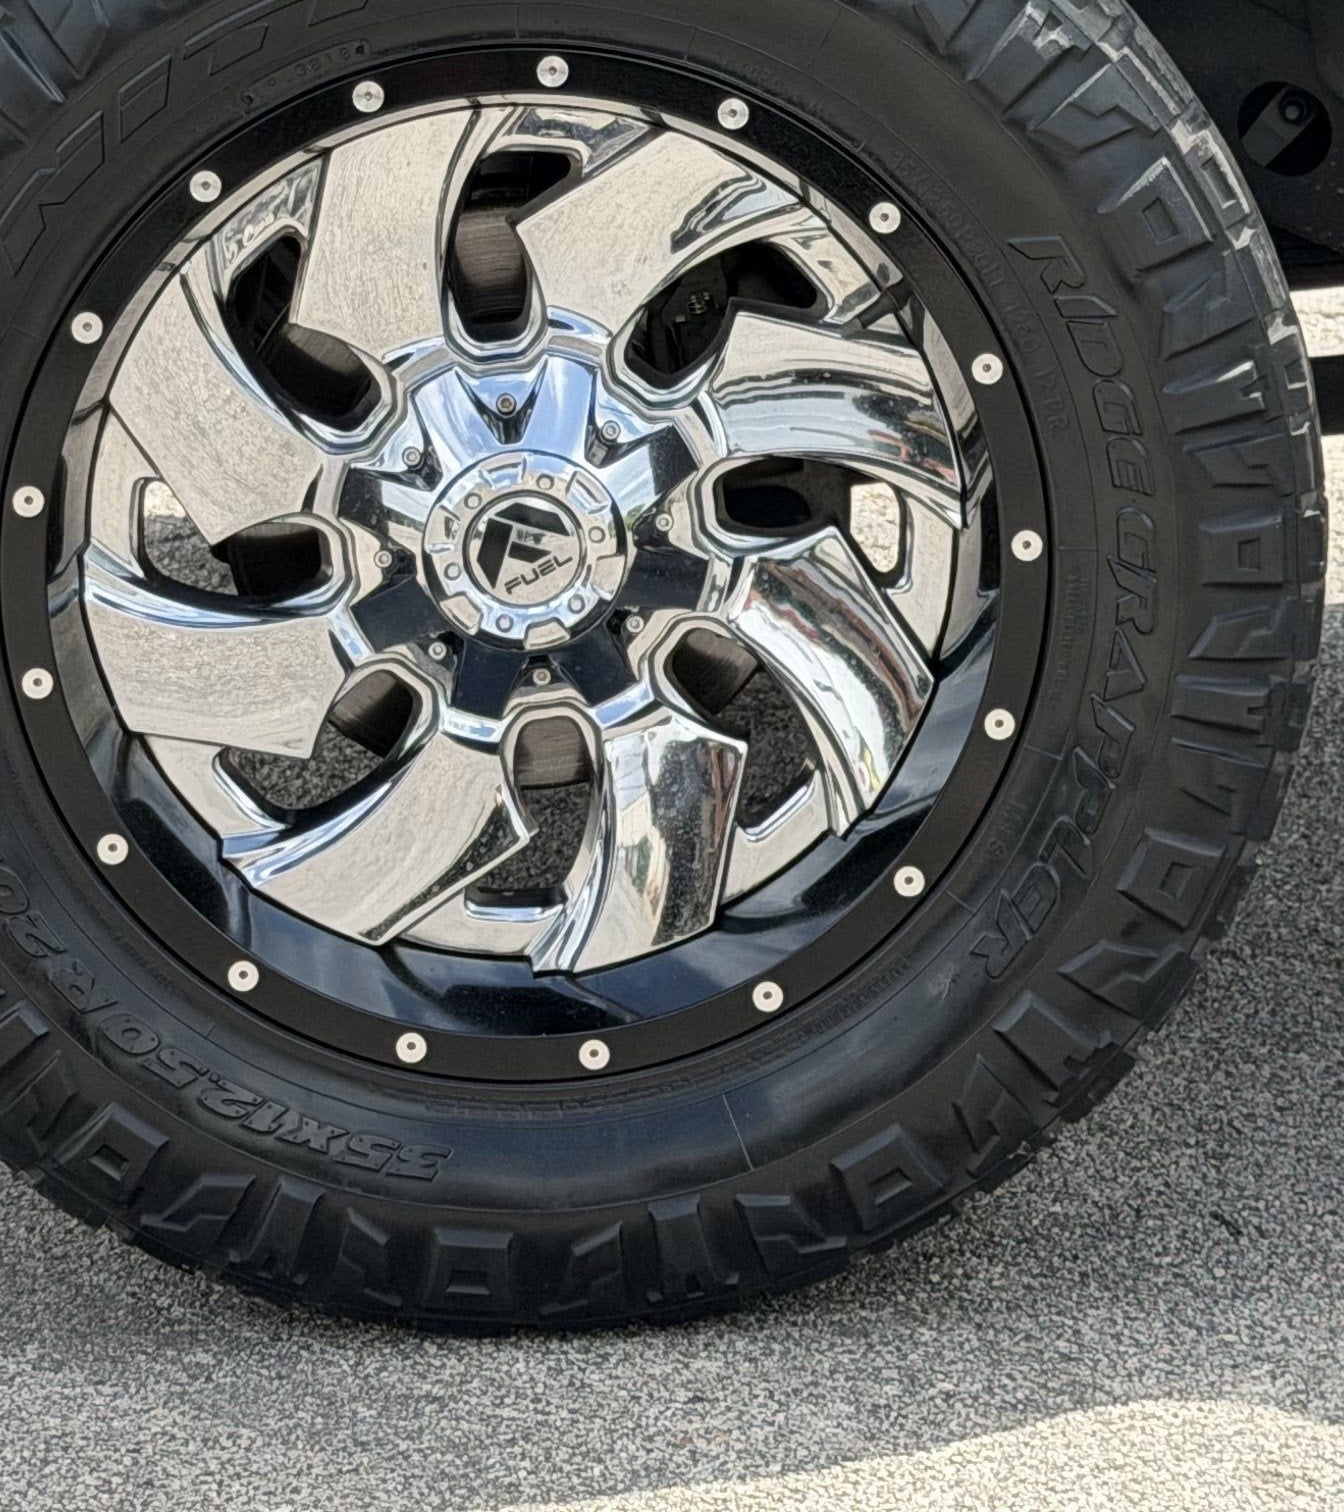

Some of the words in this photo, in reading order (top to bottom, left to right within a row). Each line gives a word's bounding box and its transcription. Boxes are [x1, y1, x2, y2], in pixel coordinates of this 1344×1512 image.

[1007, 235, 1156, 497] RIDGE
[504, 555, 573, 595] FUEL
[969, 506, 1158, 980] GRAPPLER
